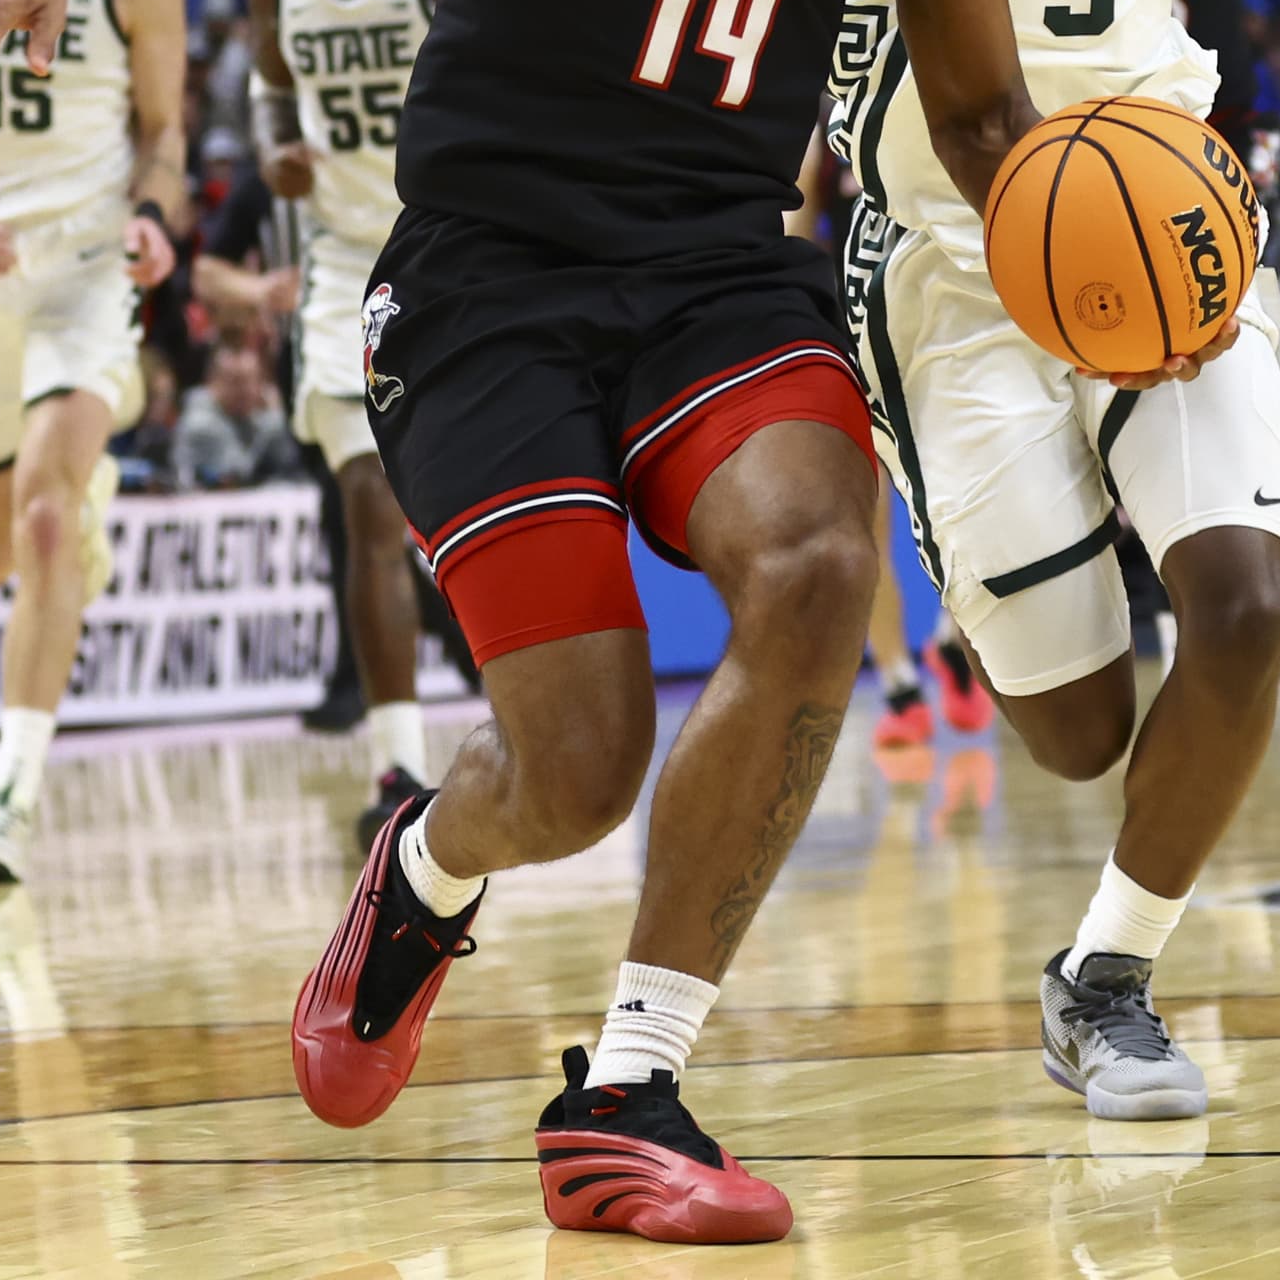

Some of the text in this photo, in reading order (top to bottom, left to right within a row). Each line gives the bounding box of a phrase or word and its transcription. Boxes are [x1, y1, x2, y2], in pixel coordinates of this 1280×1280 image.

[292, 23, 414, 75] STATE
[319, 82, 404, 150] 55
[1170, 204, 1228, 329] NCAA
[133, 515, 278, 596] ATHLETIC
